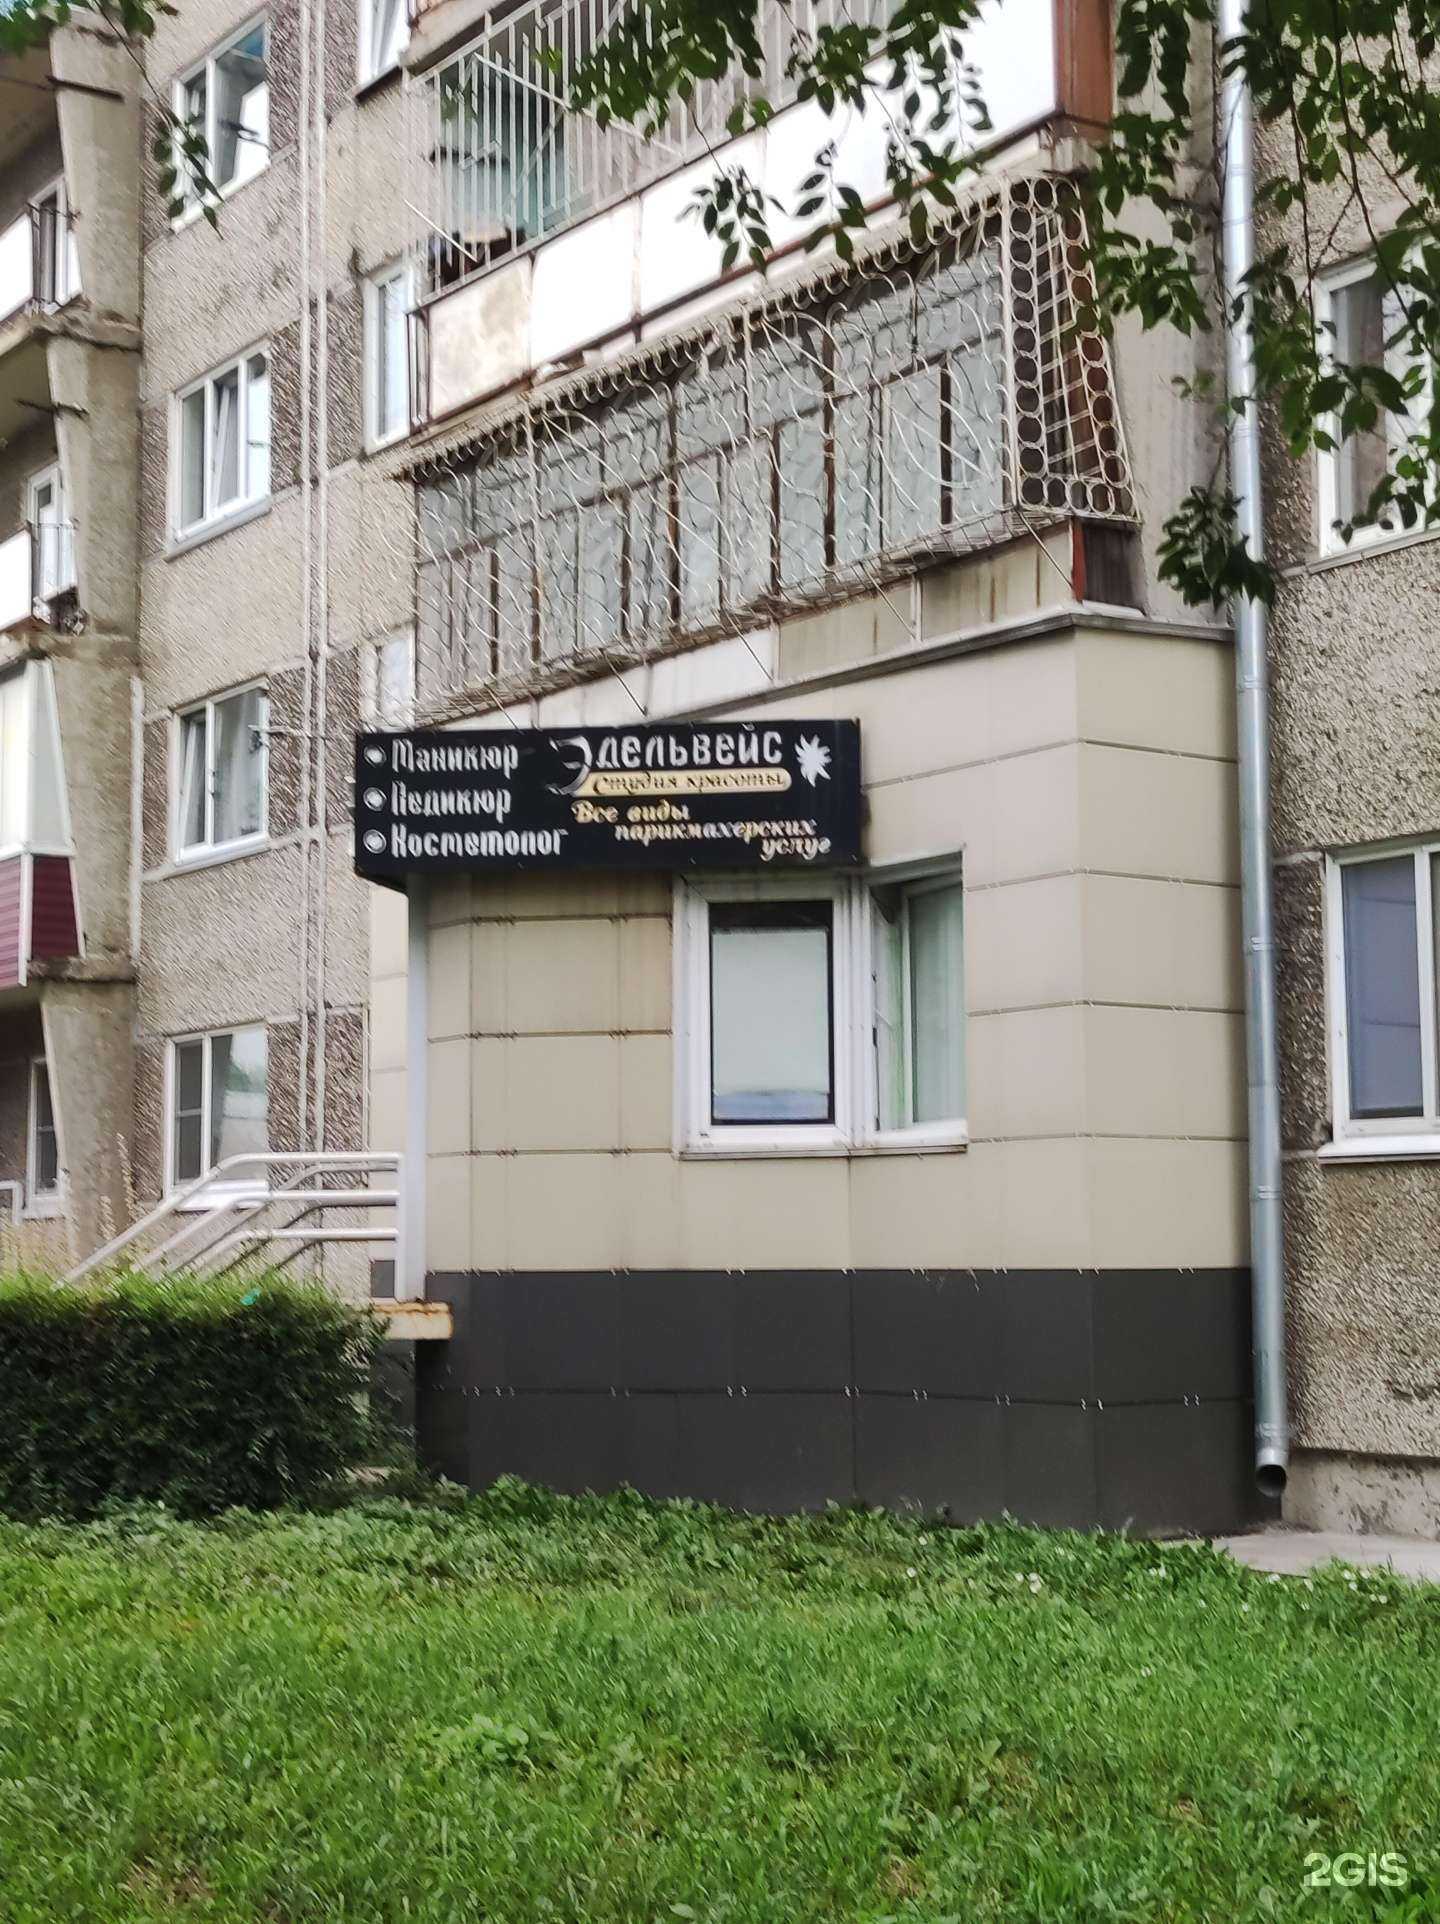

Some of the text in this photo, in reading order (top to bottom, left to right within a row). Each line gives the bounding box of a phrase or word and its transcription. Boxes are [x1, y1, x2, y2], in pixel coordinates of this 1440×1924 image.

[391, 738, 519, 780] Маникюр
[545, 723, 783, 796] Эдельвейс
[593, 771, 786, 796] Студия красоты
[391, 780, 512, 825] Педикюр
[571, 799, 691, 824] Все виды
[391, 823, 569, 858] Косметолог
[614, 819, 817, 847] парикмахерских
[760, 836, 832, 861] услуг
